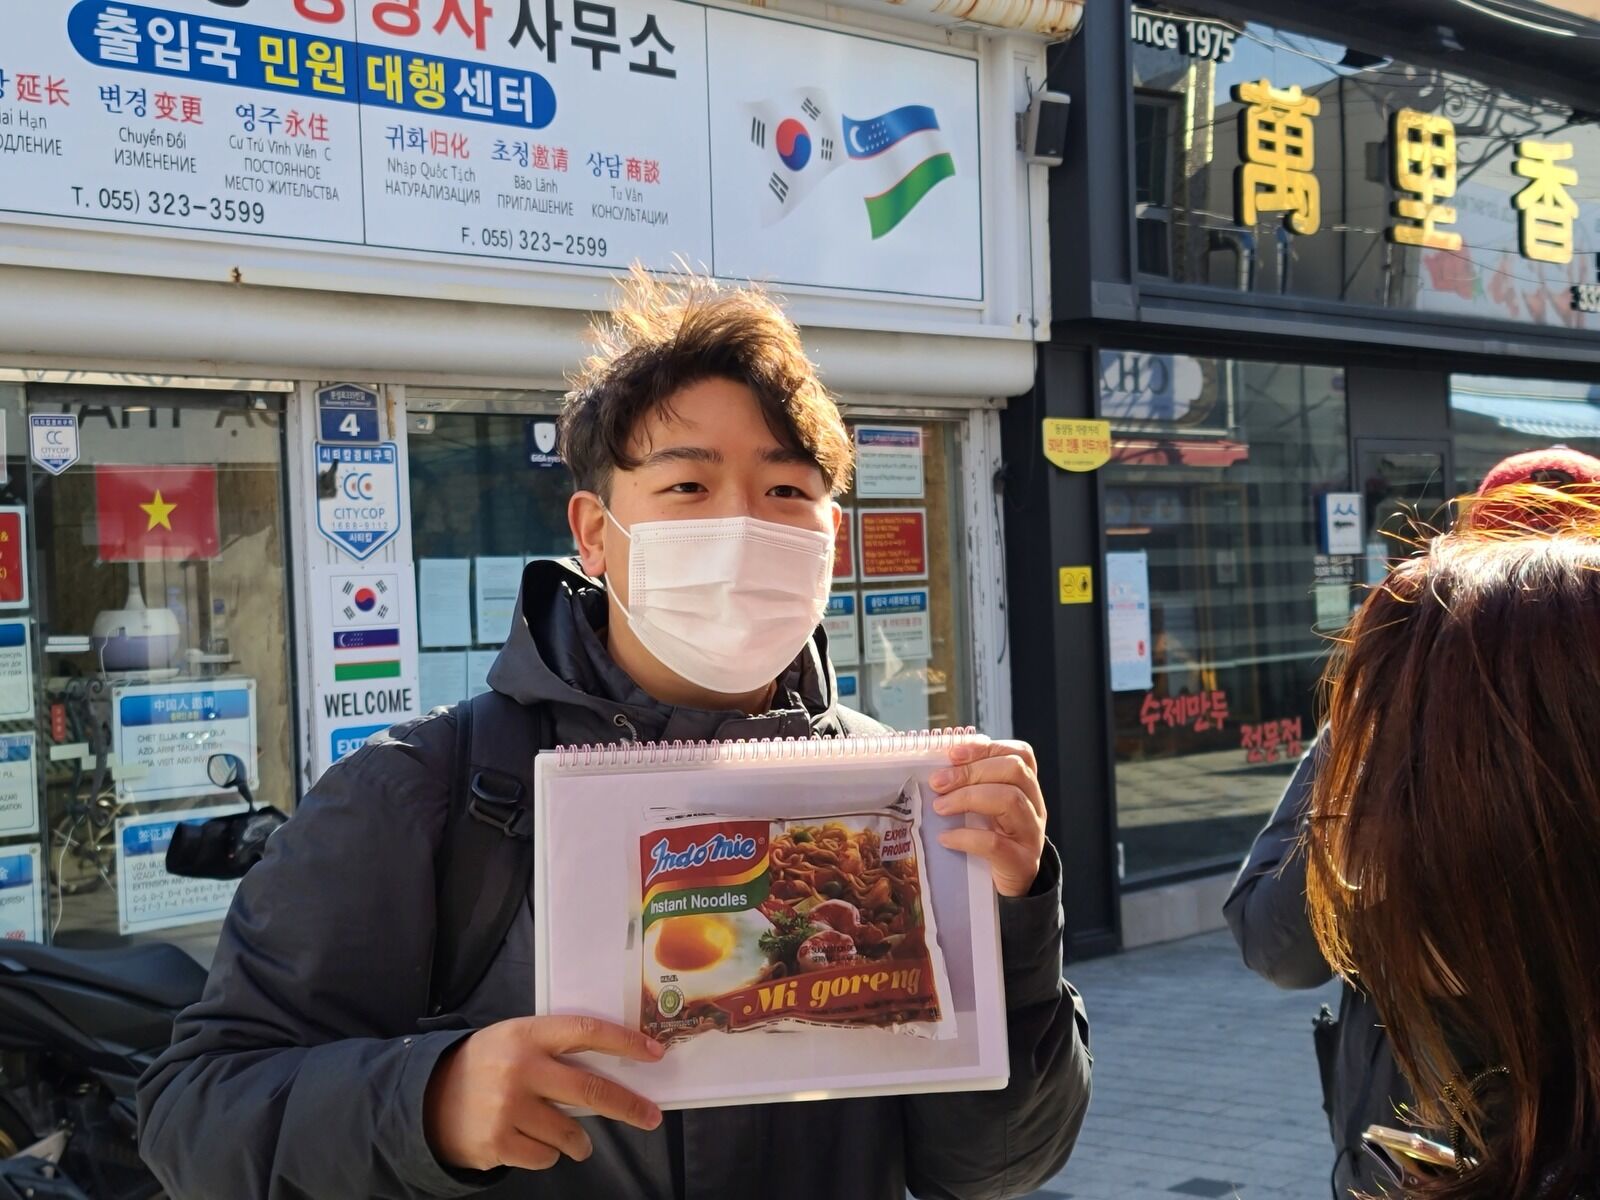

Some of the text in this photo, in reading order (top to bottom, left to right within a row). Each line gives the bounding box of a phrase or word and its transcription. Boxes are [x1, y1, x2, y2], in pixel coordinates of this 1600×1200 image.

[508, 0, 677, 79] 사무소
[1185, 22, 1236, 63] 1975
[94, 7, 533, 124] 출입국 민원 대행 센터
[15, 73, 70, 106] 延长
[98, 84, 203, 125] 변경 变更
[0, 108, 13, 125] ai
[235, 104, 330, 142] 영주 永住
[385, 125, 470, 160] 귀화 归化
[491, 139, 569, 173] 초청 邀请
[114, 148, 197, 173] ИЗМЕНЕНИЕ
[244, 157, 321, 180] ПОСТОЯННОЕ
[586, 152, 623, 179] 상담
[1236, 78, 1579, 264] 萬里香
[225, 174, 340, 202] МЕСТО ЖИТЕЛЬСТВА
[385, 179, 481, 206] НАТУРАЛИЗАЦИЯ
[71, 186, 265, 225] T. 055) 323-3599
[497, 193, 574, 217] ПРИГЛАШЕНИЕ
[591, 204, 669, 227] КОНСУЛЬТАЦИИ
[461, 226, 607, 257] F. 055) 323-2599
[339, 413, 361, 437] 4
[334, 507, 385, 520] CITYCOP
[323, 687, 413, 719] WELCOME
[1140, 690, 1229, 735] 수제만두
[1240, 715, 1303, 764] 전문점
[650, 892, 748, 915] Instant Noodles
[742, 967, 921, 1016] Mi goreng
